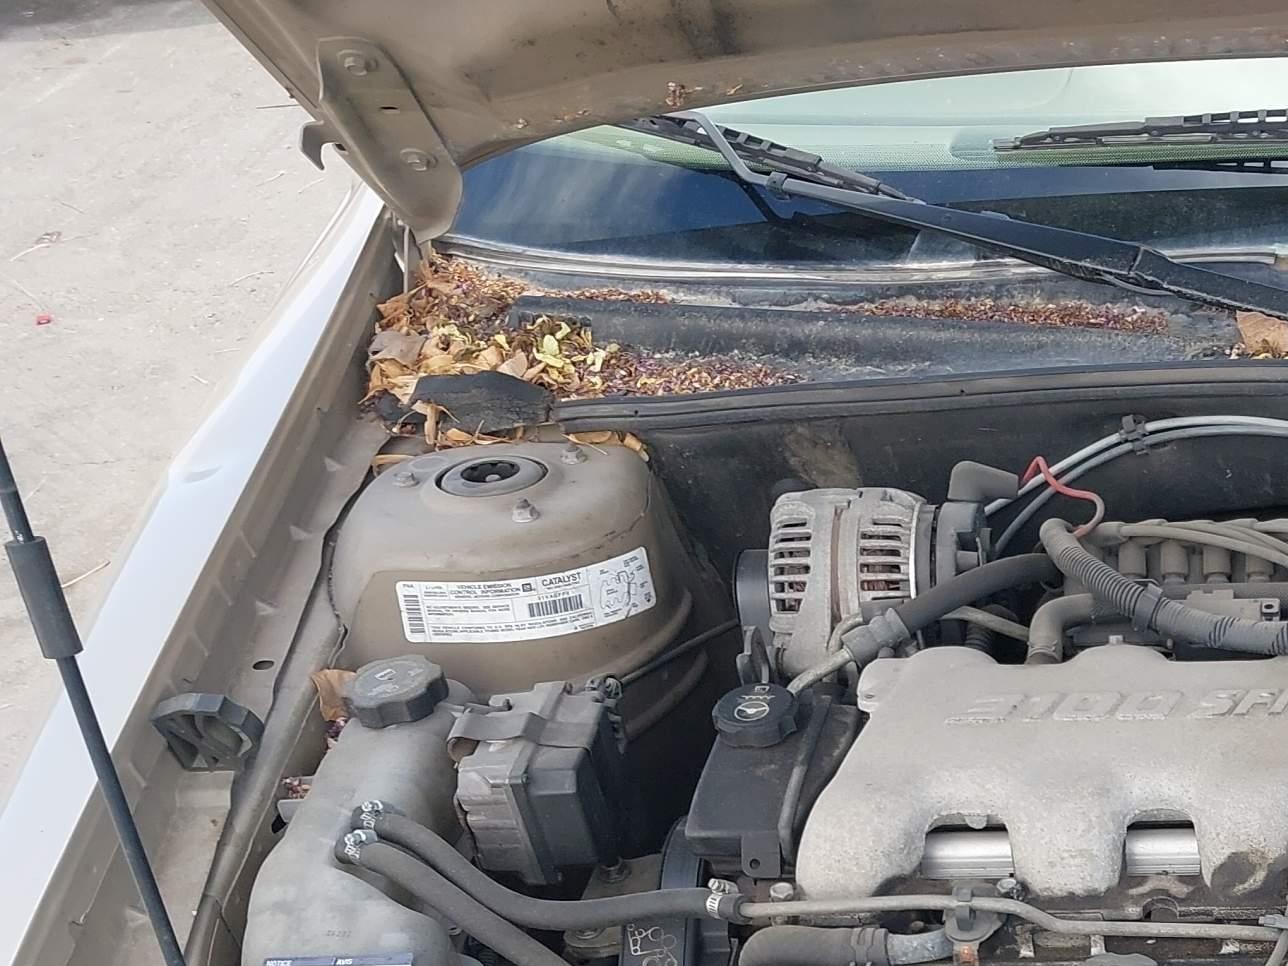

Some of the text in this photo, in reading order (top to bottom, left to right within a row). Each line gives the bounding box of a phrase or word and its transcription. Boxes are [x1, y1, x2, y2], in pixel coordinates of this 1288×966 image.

[541, 572, 581, 587] CATALYST
[945, 690, 1184, 724] 3100
[336, 958, 353, 966] AVIS
